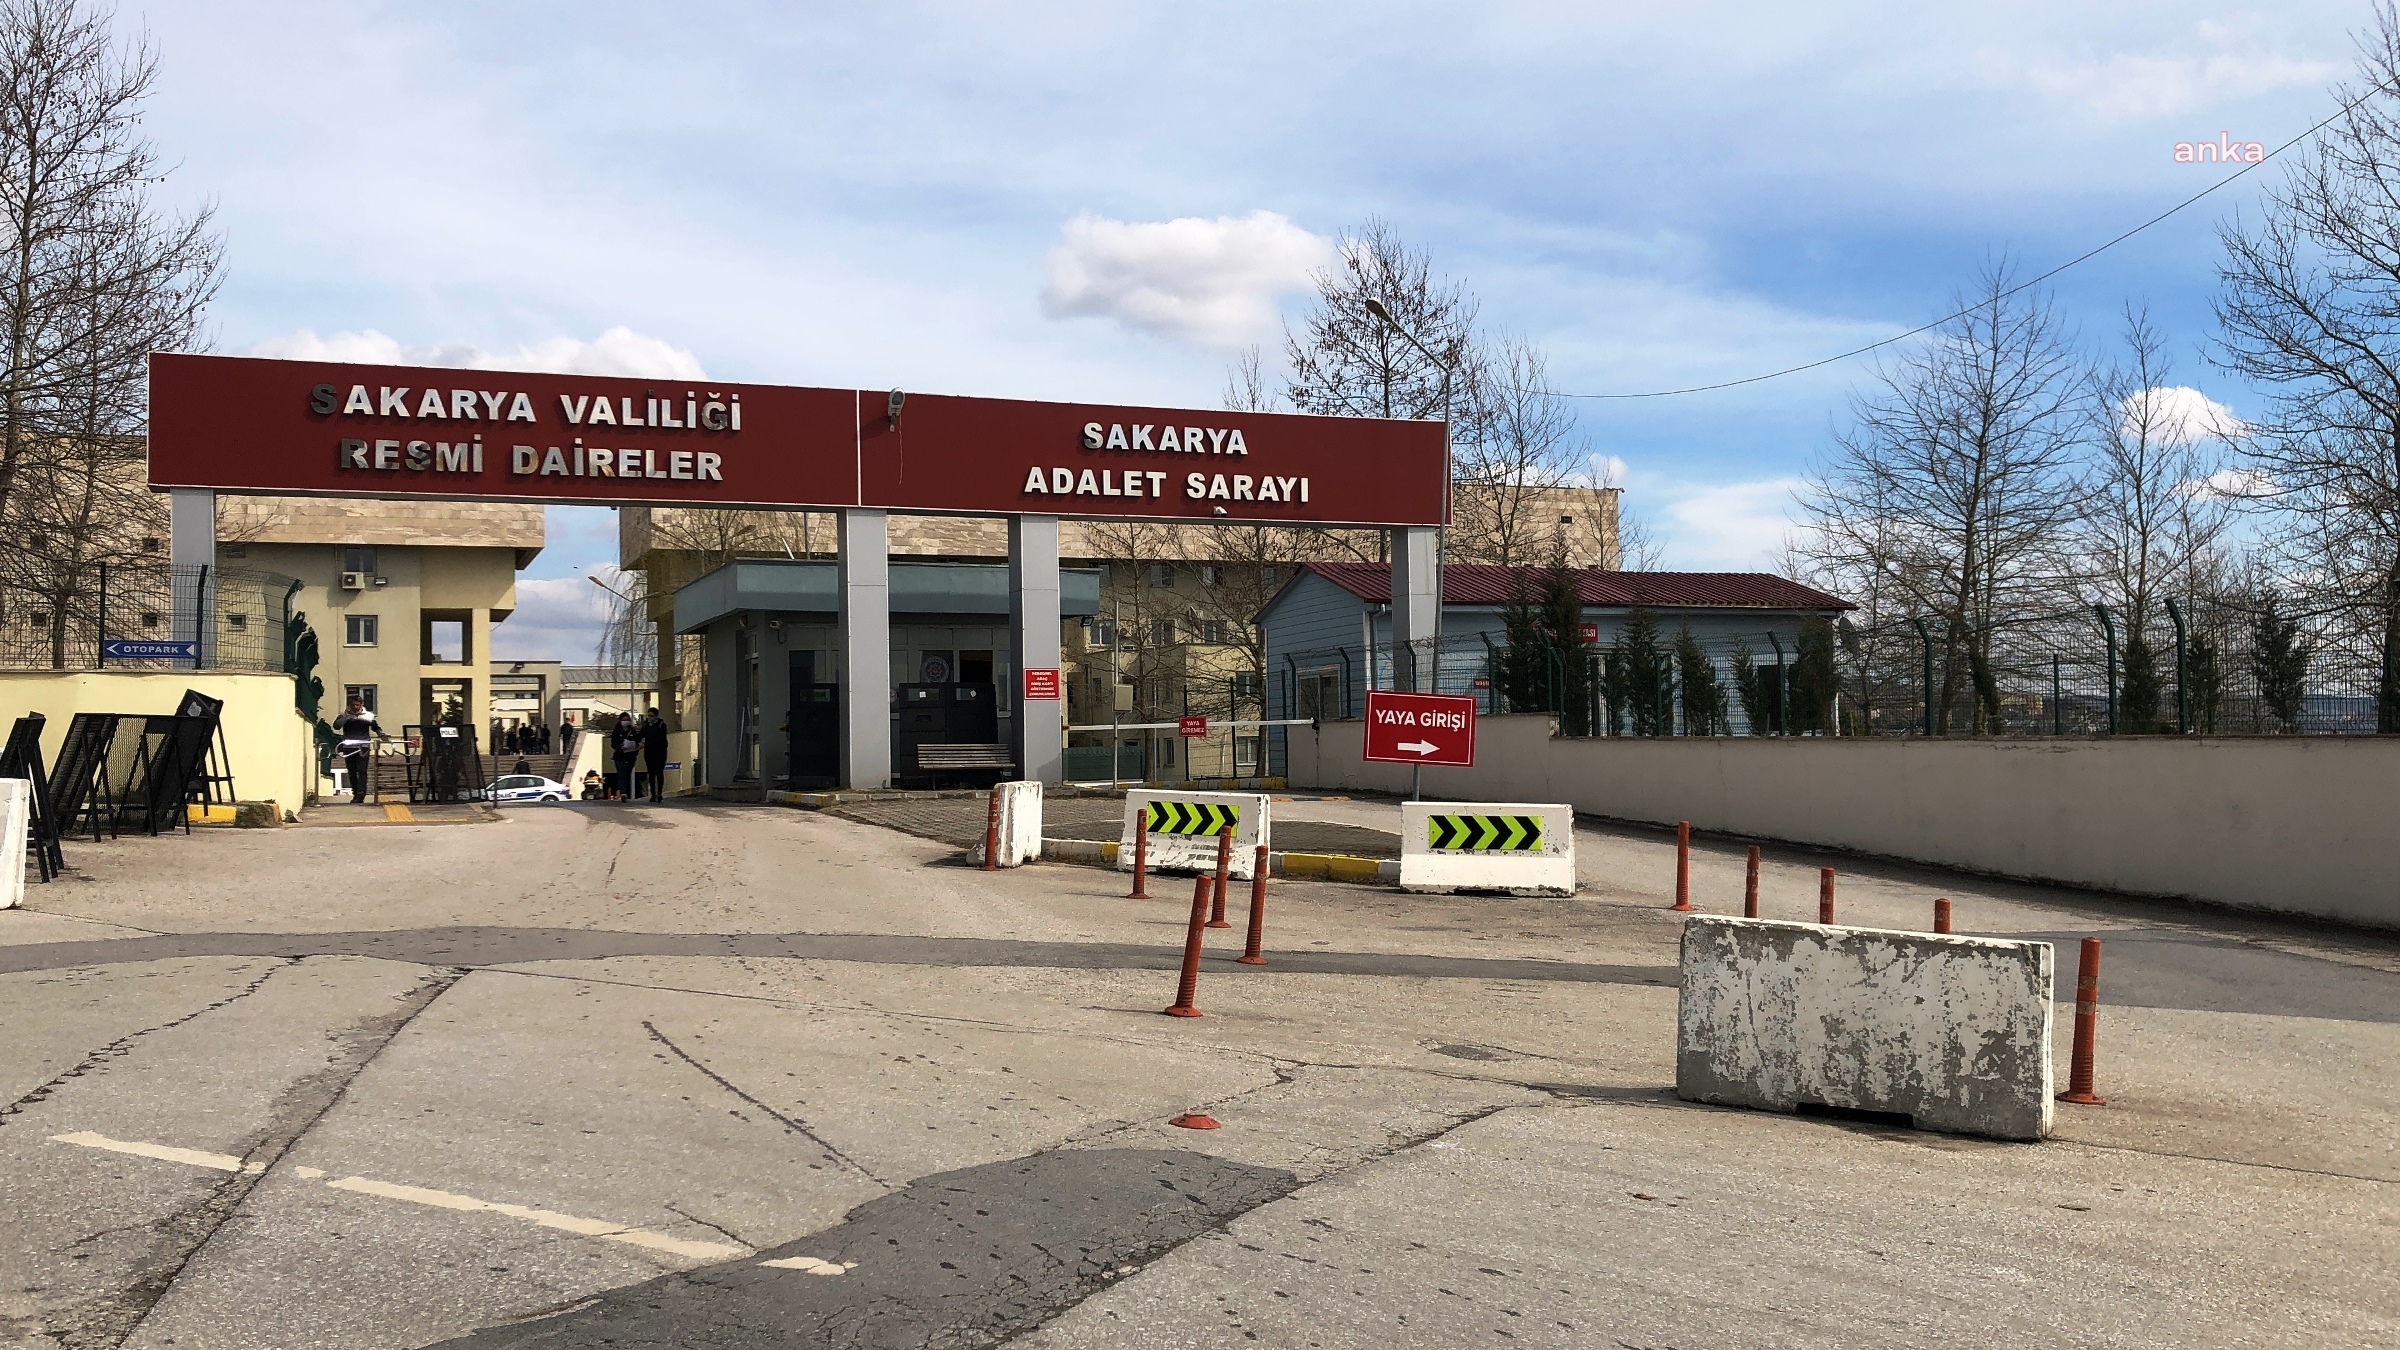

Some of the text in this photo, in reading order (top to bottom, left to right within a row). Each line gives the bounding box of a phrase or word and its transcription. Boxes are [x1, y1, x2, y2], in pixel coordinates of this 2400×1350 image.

[311, 384, 741, 431] SAKARYA VALİLİĞİ
[1083, 422, 1248, 455] SAKARYA
[341, 434, 723, 481] RESMİ DAİRELER
[1024, 466, 1309, 503] ADALET SARAYI
[123, 645, 179, 654] OTOPARK
[1375, 709, 1466, 732] YAYA GİRİŞİ
